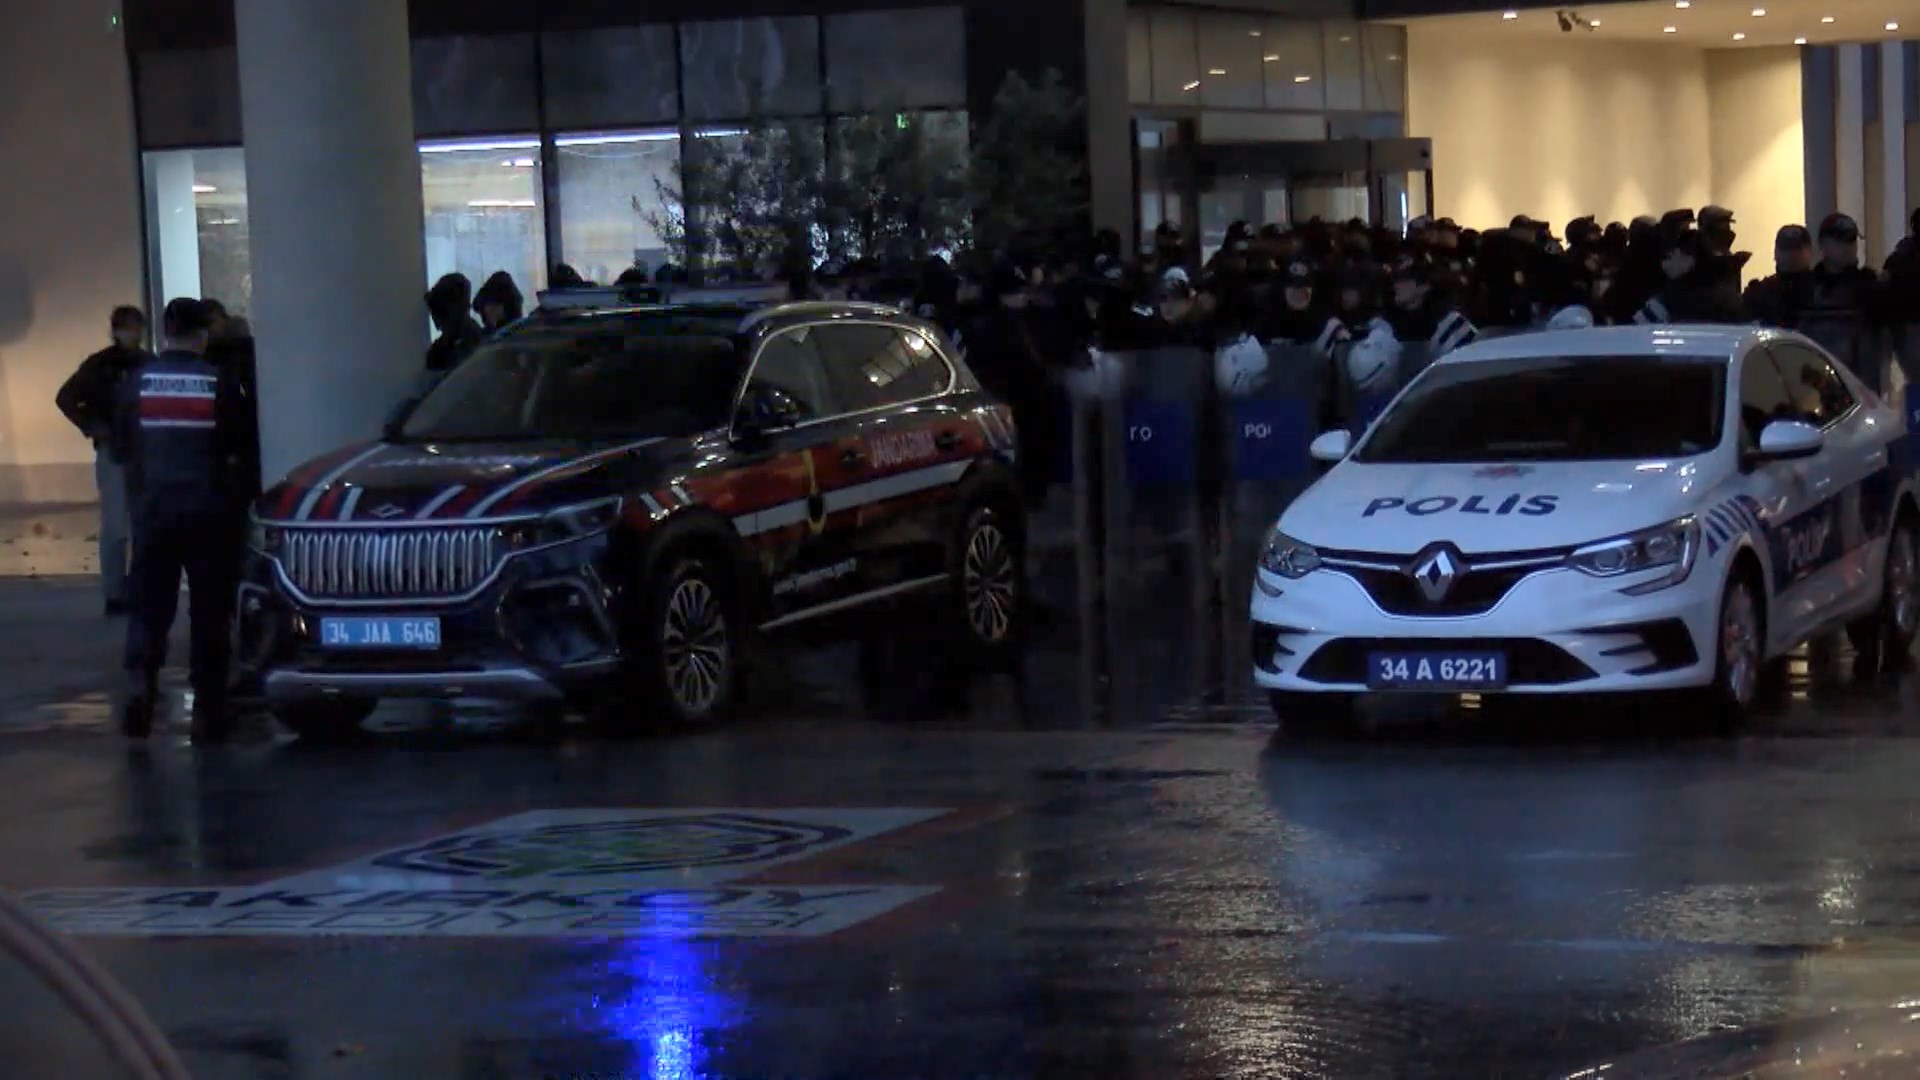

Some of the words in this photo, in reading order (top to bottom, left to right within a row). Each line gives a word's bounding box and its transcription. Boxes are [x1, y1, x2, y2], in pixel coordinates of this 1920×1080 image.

[328, 622, 349, 643] 34
[361, 622, 391, 643] JAA
[1380, 658, 1409, 680] 34
[1416, 657, 1433, 680] A
[1440, 658, 1496, 680] 6221
